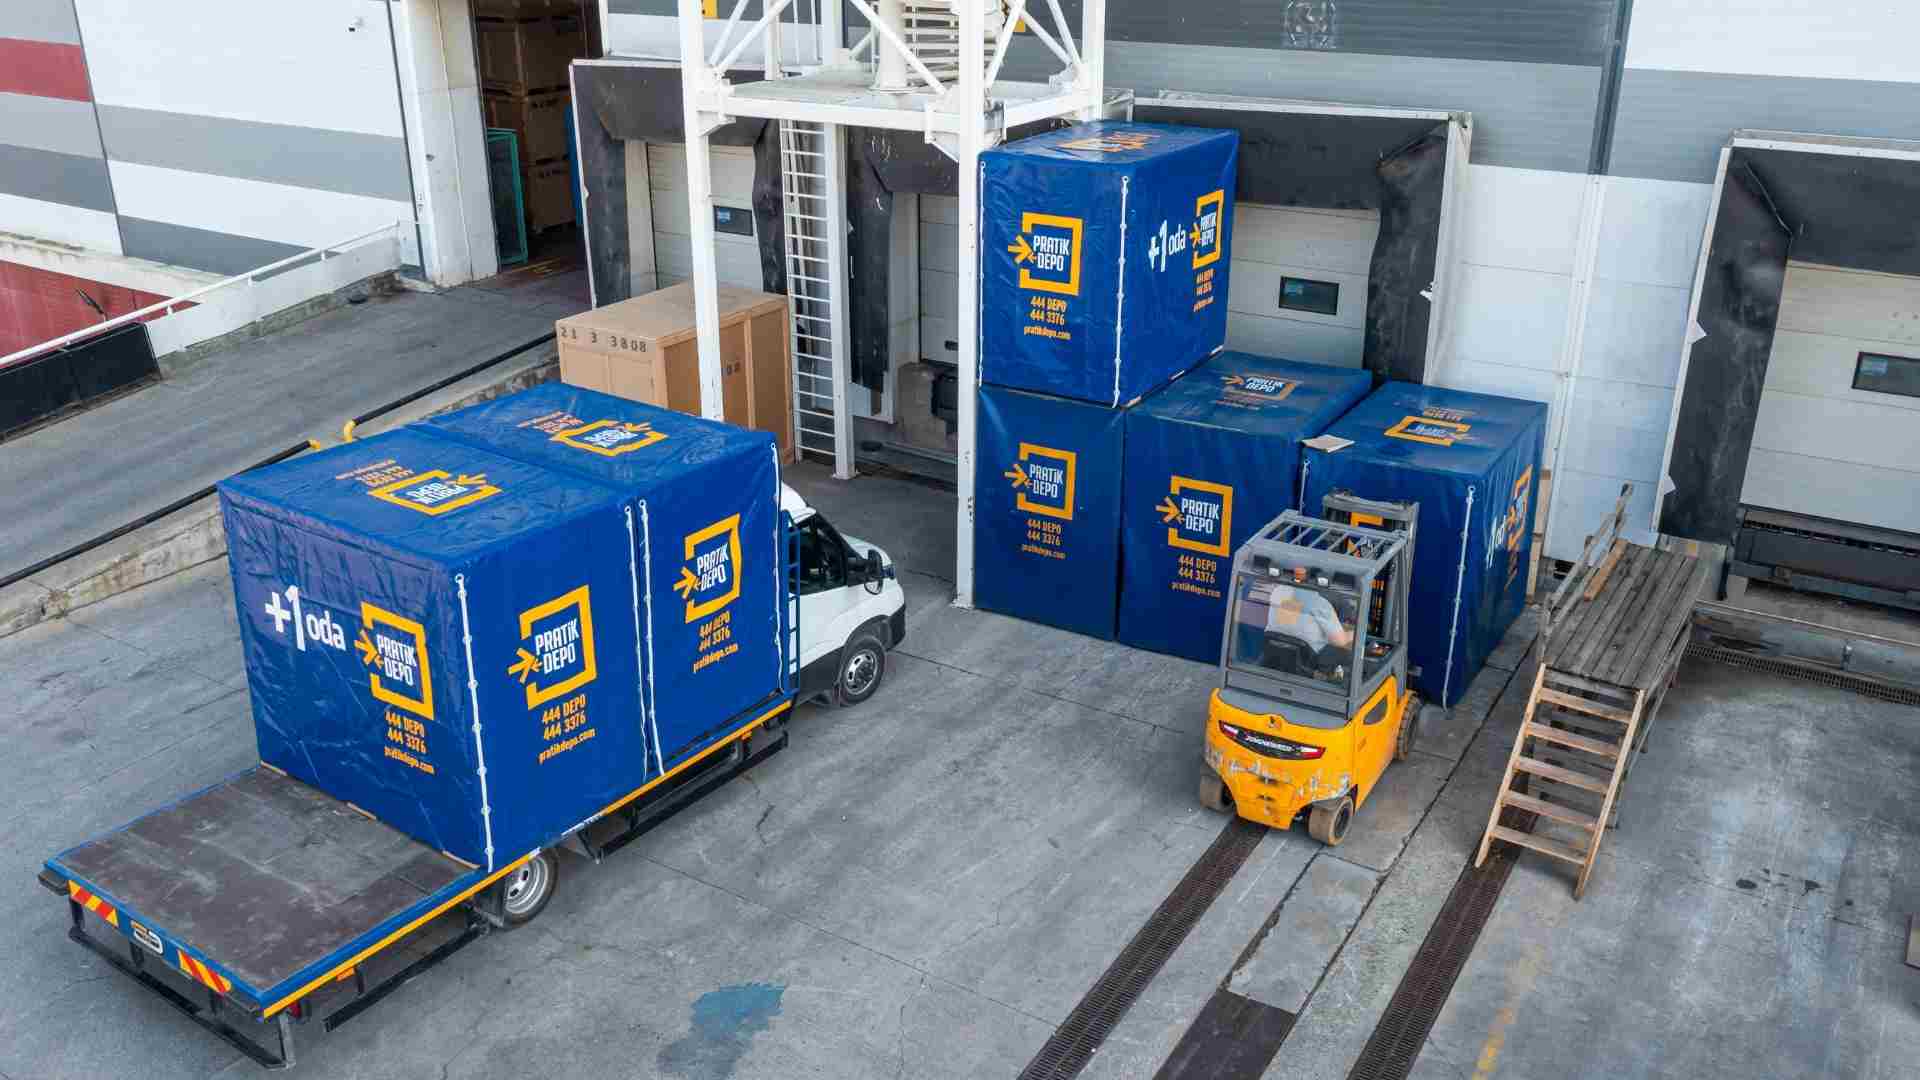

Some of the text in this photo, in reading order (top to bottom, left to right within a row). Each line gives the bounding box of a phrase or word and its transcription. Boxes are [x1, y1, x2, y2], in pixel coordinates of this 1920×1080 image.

[1168, 223, 1186, 256] oda
[1036, 252, 1065, 272] DEPO
[559, 325, 648, 353] 21 3 3808
[1032, 479, 1058, 498] DEPO
[1185, 515, 1214, 534] DEPO
[700, 564, 727, 592] DEPO
[264, 584, 347, 652] +1 oda
[383, 655, 414, 687] DEPO
[542, 642, 577, 675] DEPO
[541, 693, 587, 725] 444 DEPO
[543, 710, 587, 741] 444 3376
